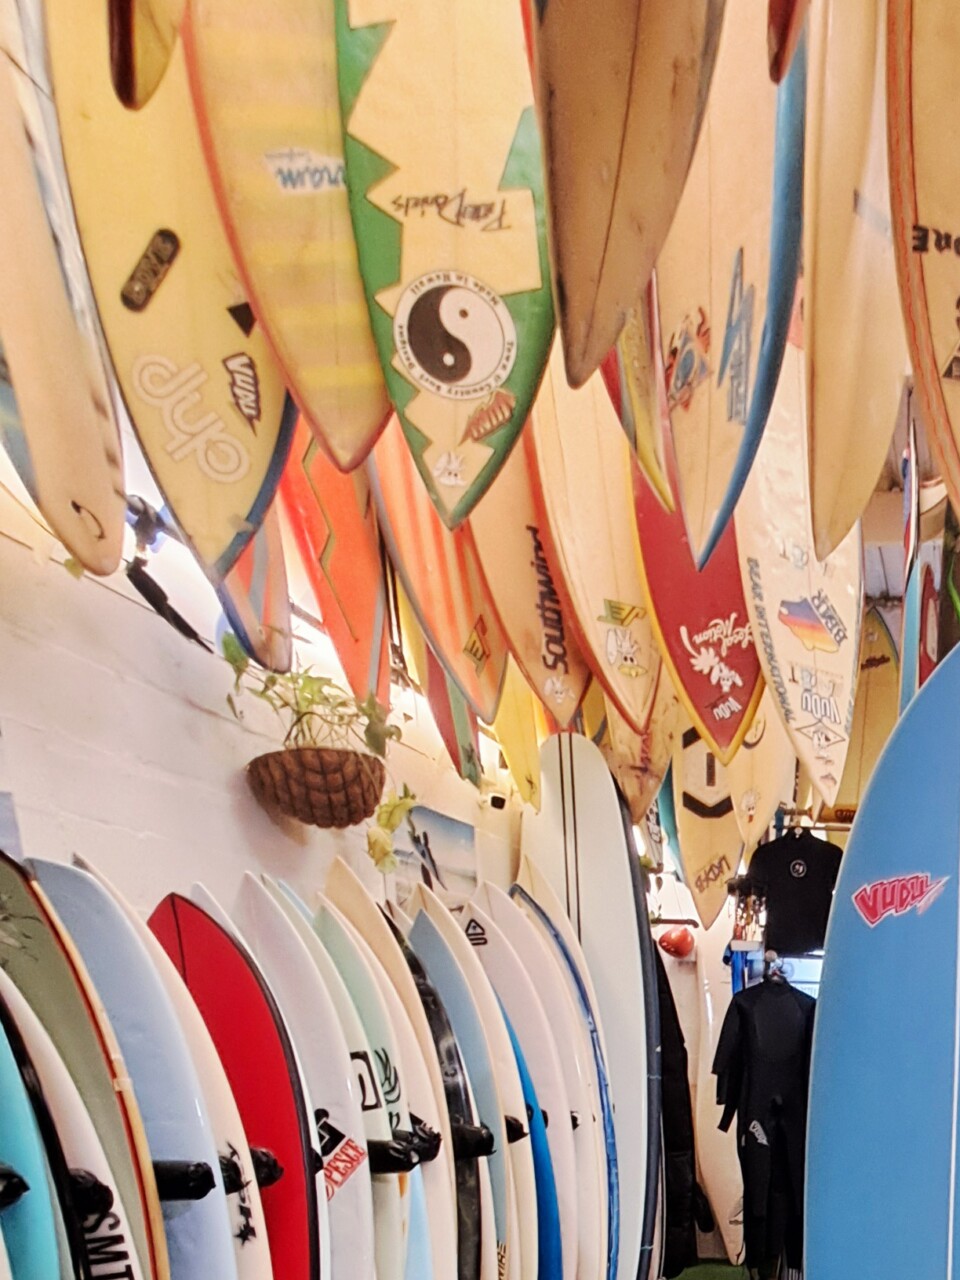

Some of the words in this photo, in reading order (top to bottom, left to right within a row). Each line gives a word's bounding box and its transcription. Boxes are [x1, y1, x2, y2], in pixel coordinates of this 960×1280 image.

[526, 525, 569, 675] Southwind
[693, 612, 738, 646] Motion
[721, 619, 755, 657] Local
[851, 872, 946, 928] VUDU
[324, 1138, 368, 1189] PESCE
